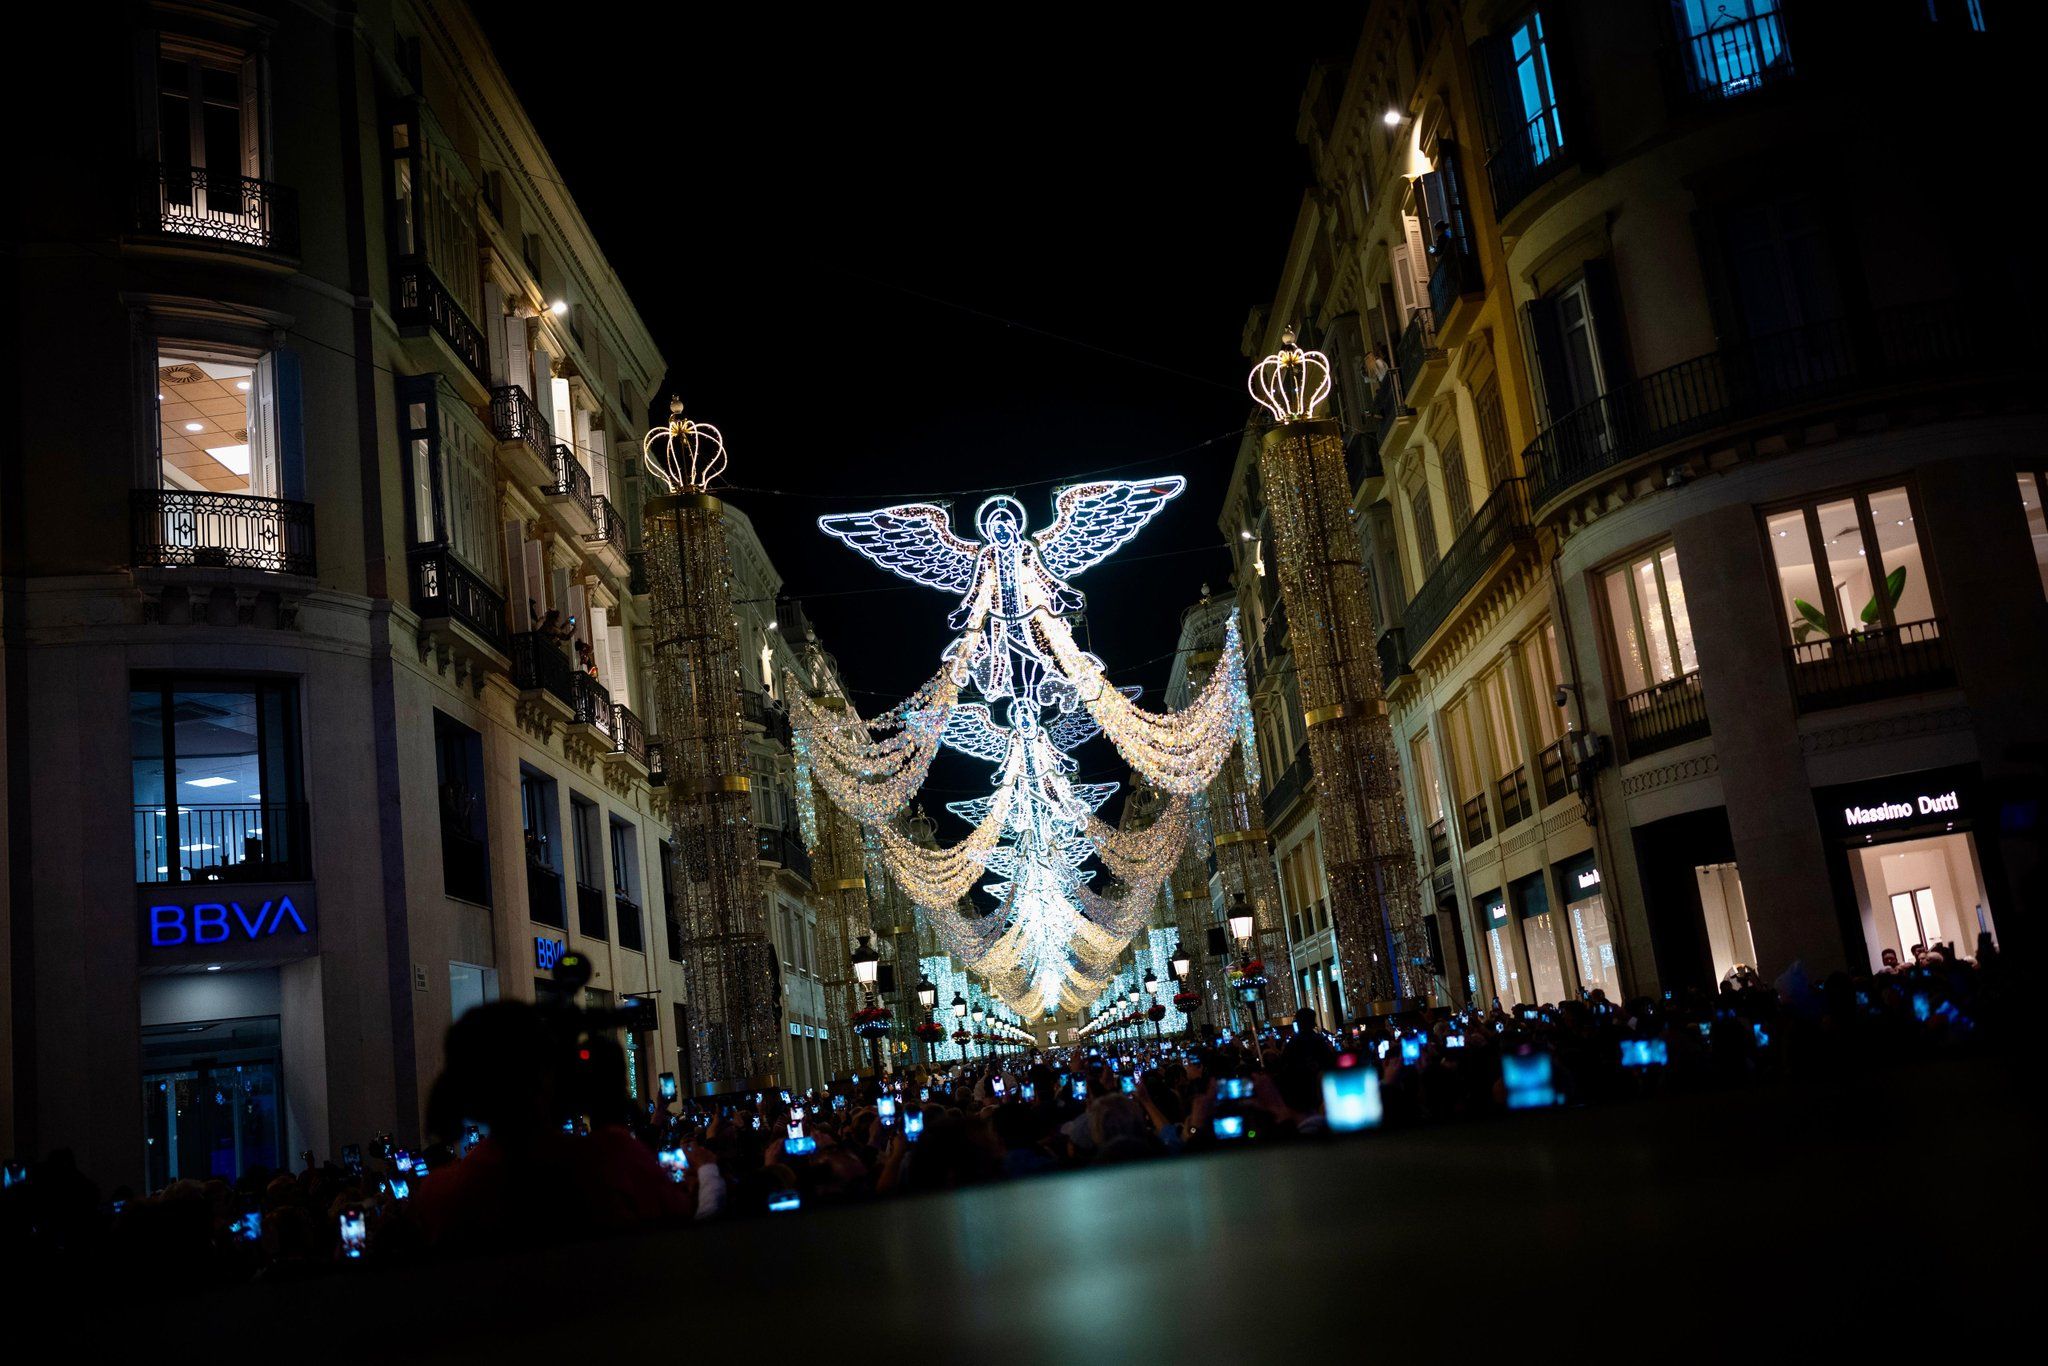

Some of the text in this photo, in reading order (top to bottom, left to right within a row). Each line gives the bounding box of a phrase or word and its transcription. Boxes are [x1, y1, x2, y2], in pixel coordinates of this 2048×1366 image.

[1845, 791, 1959, 826] Massimo Dutti
[150, 895, 308, 946] BBVA
